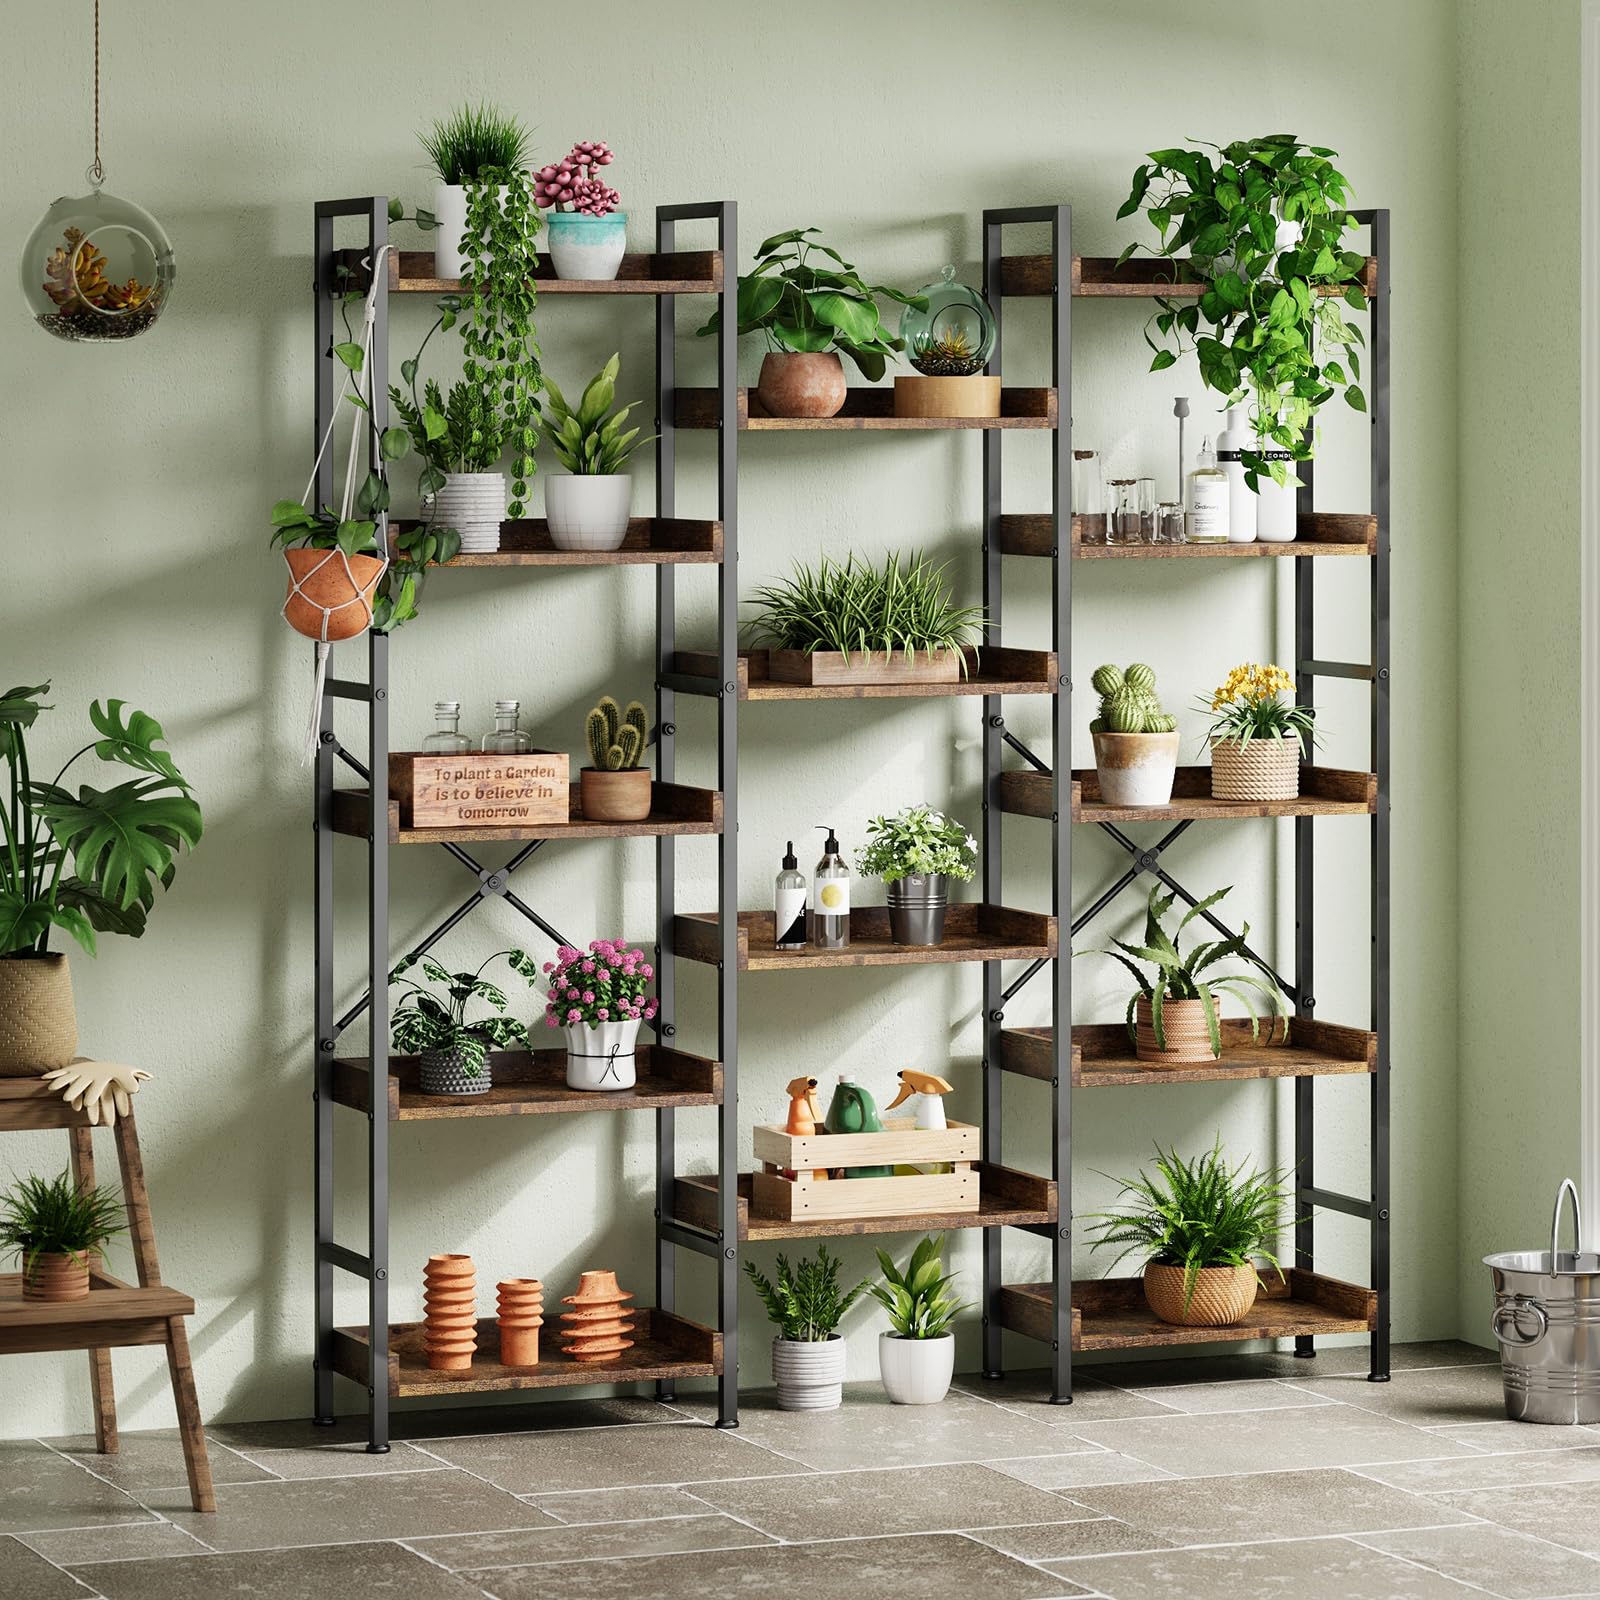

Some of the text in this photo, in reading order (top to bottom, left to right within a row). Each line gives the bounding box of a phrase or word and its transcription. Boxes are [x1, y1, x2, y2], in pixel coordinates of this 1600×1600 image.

[434, 765, 556, 783] To plant a Garden
[435, 784, 553, 801] is to believe in
[457, 806, 530, 819] tomorrow
